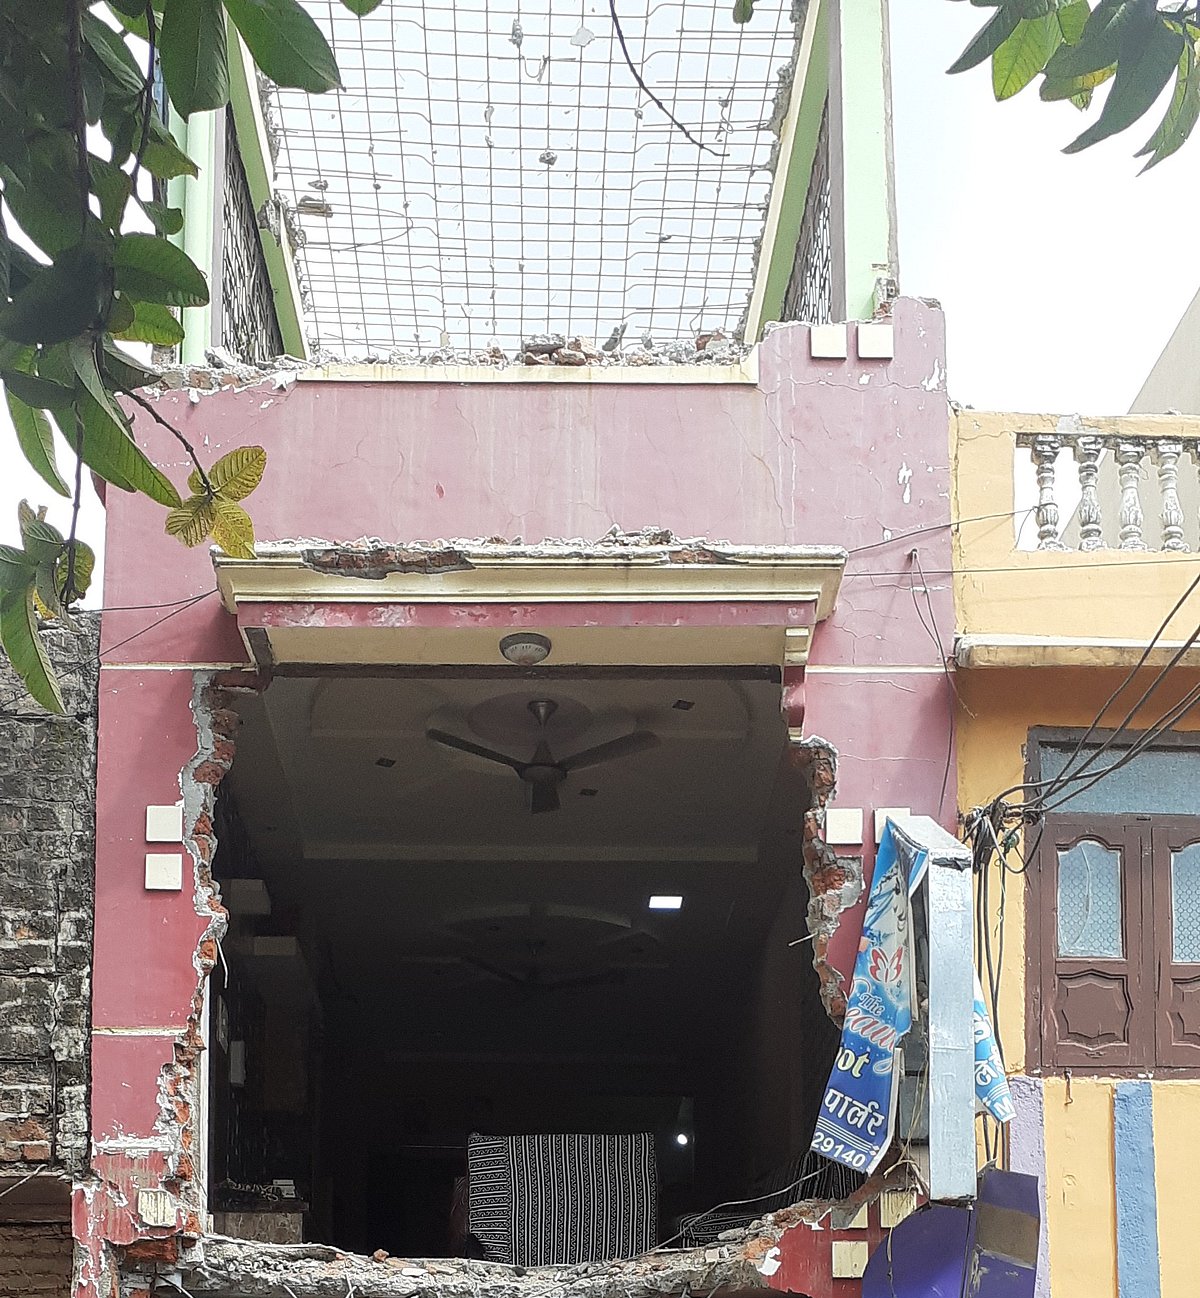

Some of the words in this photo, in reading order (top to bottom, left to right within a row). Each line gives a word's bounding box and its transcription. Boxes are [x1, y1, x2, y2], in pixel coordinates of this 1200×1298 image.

[859, 992, 885, 1015] The
[824, 1087, 886, 1136] पार्लर
[811, 1131, 867, 1168] 29140
